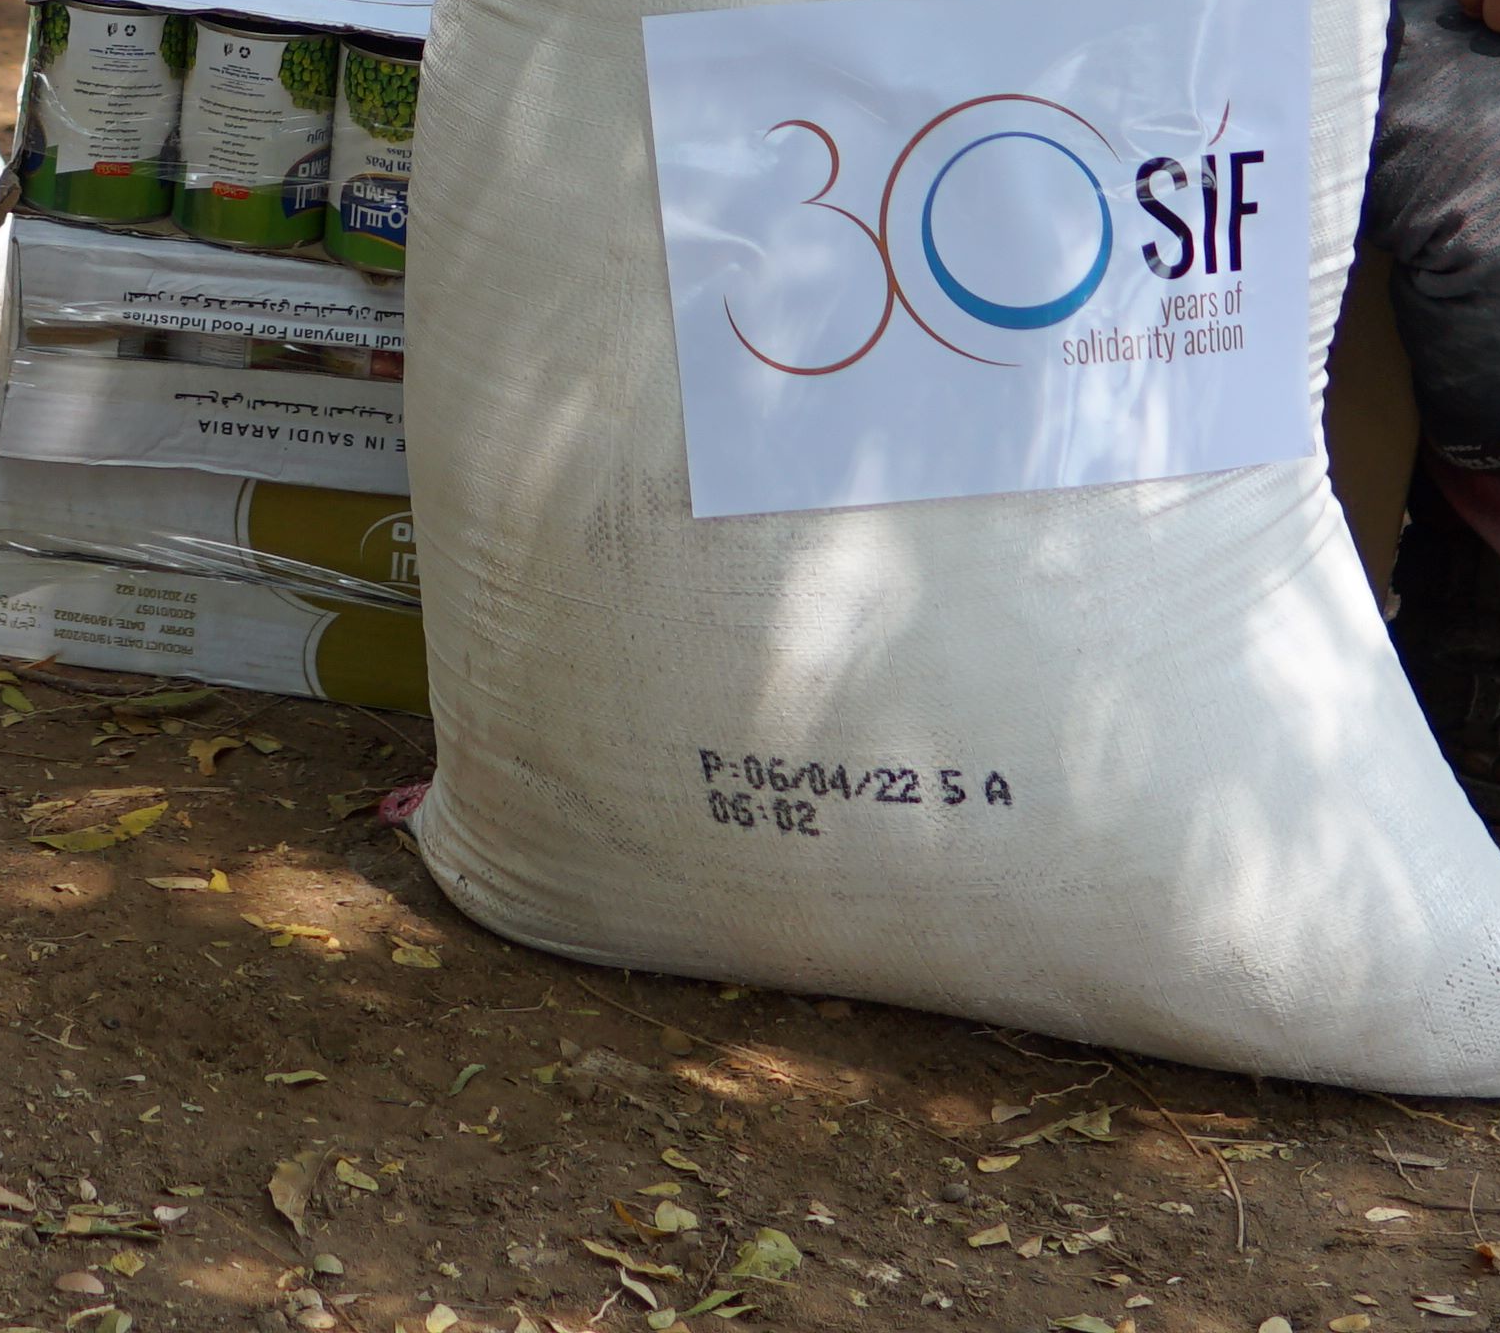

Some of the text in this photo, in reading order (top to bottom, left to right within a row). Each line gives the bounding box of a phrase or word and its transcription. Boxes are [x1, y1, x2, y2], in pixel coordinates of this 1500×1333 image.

[365, 154, 394, 173] Peas
[349, 202, 407, 230] السم
[180, 294, 227, 309] شركة
[231, 297, 290, 313] سعودي
[1159, 281, 1245, 328] years of
[122, 309, 207, 332] Industries
[211, 318, 254, 334] Food
[259, 321, 288, 336] For
[294, 324, 370, 348] Tianyuan
[1062, 318, 1245, 367] solidarity action
[174, 389, 219, 406] صنع
[221, 392, 244, 408] في
[246, 399, 319, 417] المملكة
[323, 405, 394, 424] العربية
[198, 419, 280, 440] ARABIA
[288, 428, 355, 447] SAUDI
[364, 435, 385, 451] IN
[183, 592, 198, 604] 57
[938, 769, 967, 806] 5
[984, 770, 1013, 807] A
[708, 788, 821, 837] 06:02
